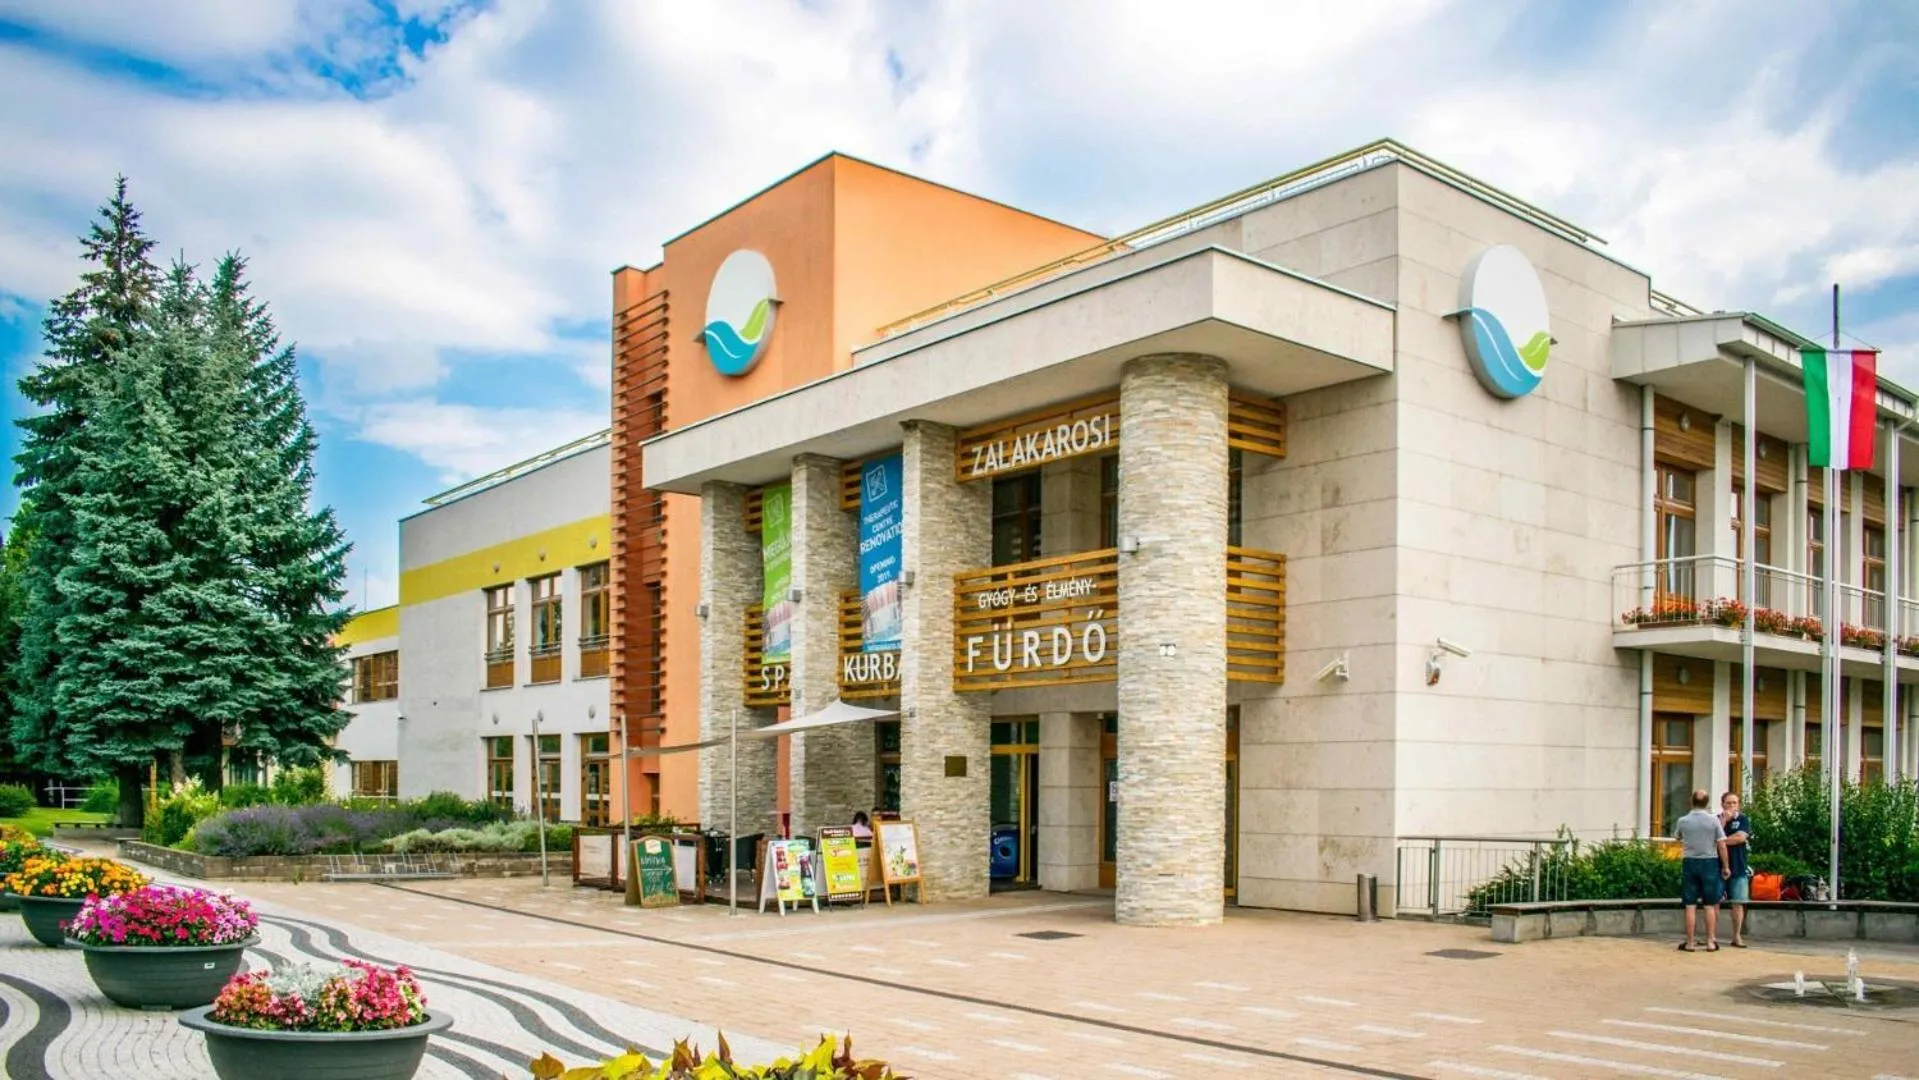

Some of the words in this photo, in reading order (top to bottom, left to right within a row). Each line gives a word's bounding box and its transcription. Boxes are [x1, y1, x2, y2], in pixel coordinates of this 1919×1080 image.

[971, 413, 1110, 476] ZALAKAROSI
[860, 521, 903, 555] RENOVATIO
[967, 609, 1106, 672] FÜRDŐ
